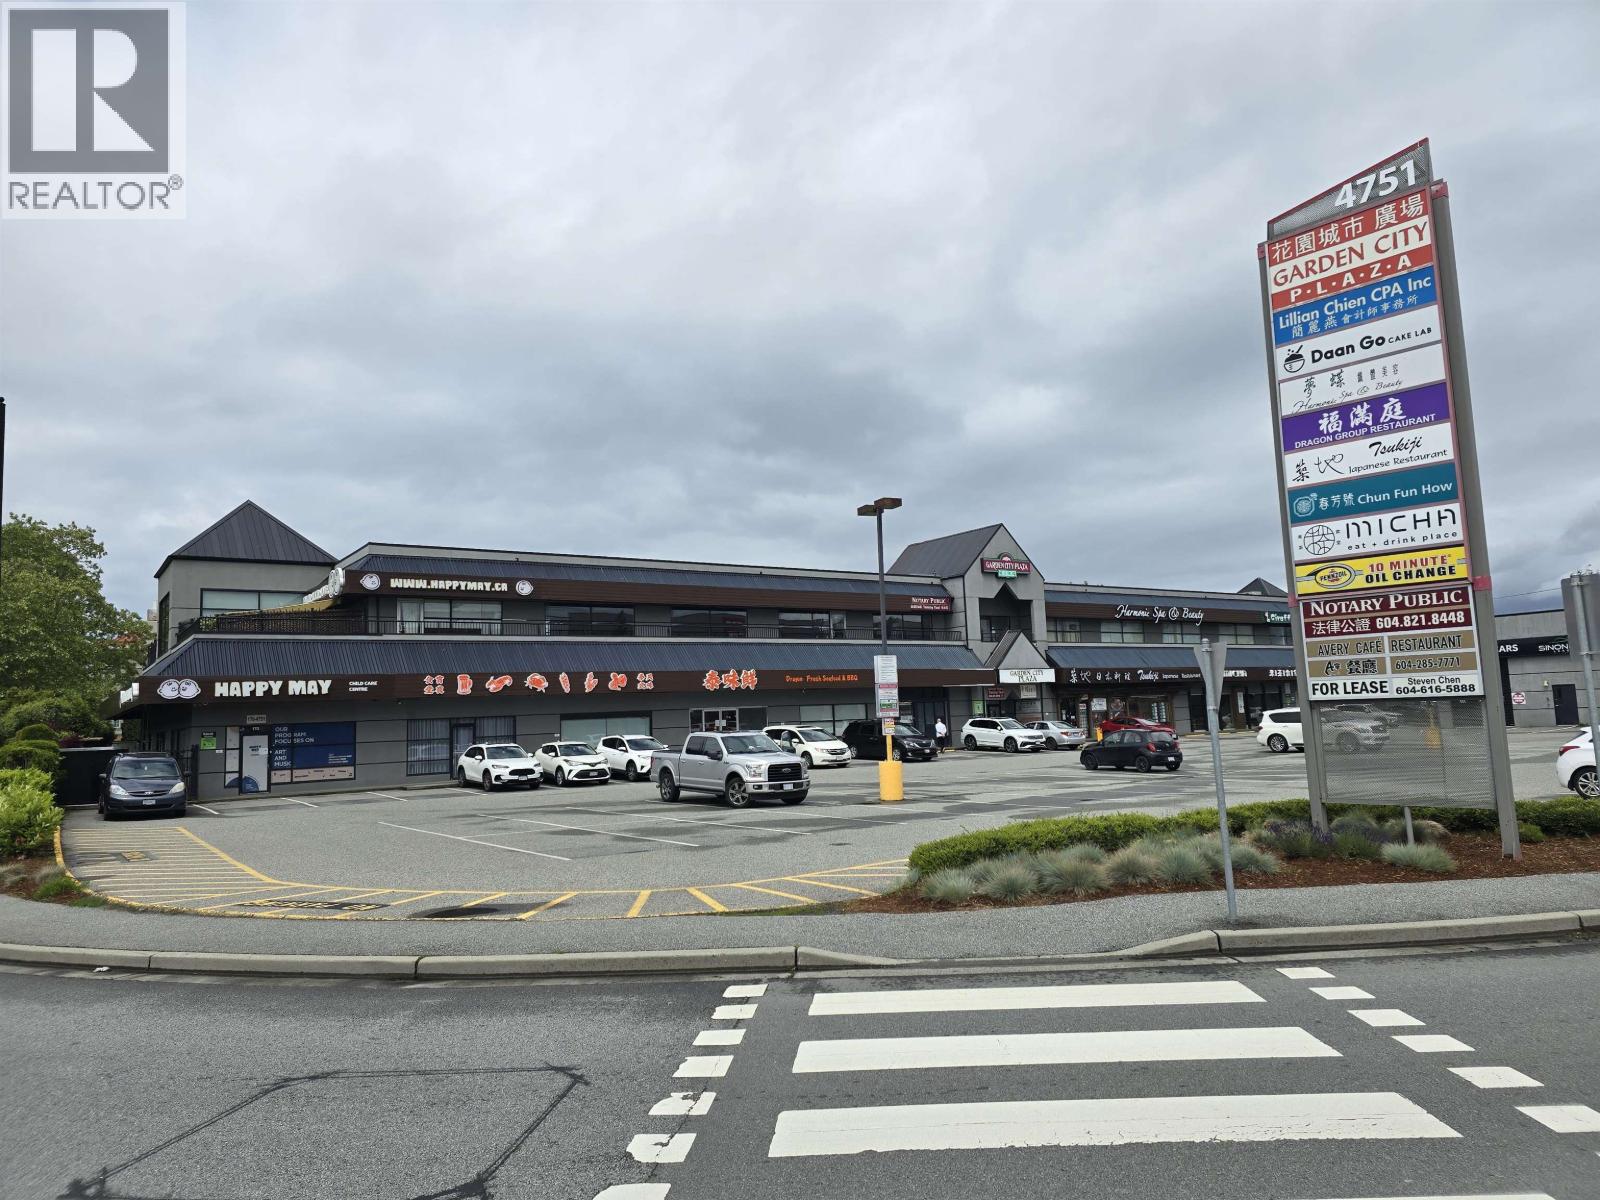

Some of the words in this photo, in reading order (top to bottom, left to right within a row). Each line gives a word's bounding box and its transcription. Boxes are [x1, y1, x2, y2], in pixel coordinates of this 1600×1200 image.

[1335, 159, 1416, 209] 4751
[1272, 215, 1364, 263] 花園城市
[1375, 194, 1424, 229] 廣場
[1273, 242, 1365, 286] GARDEN
[1374, 221, 1427, 254] CITY
[1279, 309, 1319, 329] Lillian
[1324, 296, 1367, 314] Chien
[1371, 282, 1403, 302] CPA
[1408, 277, 1431, 291] Inc
[1311, 343, 1355, 364] Daan
[1359, 335, 1386, 351] Go
[1388, 333, 1412, 344] CAKE
[1415, 327, 1432, 337] LAB
[1339, 390, 1353, 403] Spa
[1376, 379, 1403, 390] Beauty
[1319, 397, 1407, 435] 福滿庭
[1294, 434, 1333, 449] DRAGON
[1335, 427, 1367, 441] GROUP
[1370, 413, 1436, 433] RESTAURANT
[1369, 436, 1422, 457] Tsukiji
[1348, 459, 1390, 474] Japanese
[1393, 449, 1448, 465] Restaurant
[1318, 492, 1355, 511] 春芳號
[1358, 490, 1390, 504] Chun
[1394, 488, 1418, 499] Fun
[1422, 482, 1453, 495] How
[1348, 542, 1366, 551] eat
[1383, 536, 1416, 546] drink
[1422, 531, 1458, 543] place
[985, 561, 1004, 570] GARDEN
[1365, 572, 1388, 584] OIL
[1393, 565, 1456, 581] CHANGE
[1369, 562, 1385, 574] 10
[1390, 555, 1448, 571] MINUTE
[1320, 571, 1347, 582] PENNZOIL
[1311, 598, 1384, 616] NOTARY
[1388, 590, 1463, 609] PUBLIC
[1115, 604, 1150, 619] Harmonic
[1152, 606, 1167, 624] Spa
[1182, 607, 1205, 626] Beauty
[1312, 619, 1371, 635] 法律公證
[1376, 611, 1465, 629] 604.821.8448
[1318, 643, 1350, 657] AVERY
[1356, 639, 1382, 654] CAFÉ
[1391, 635, 1462, 648] RESTAURANT
[1395, 656, 1460, 670] 604-285-7771
[214, 680, 283, 697] HAPPY
[288, 679, 332, 696] MAY
[1312, 682, 1339, 696] FOR
[1343, 681, 1388, 695] LEASE
[1395, 684, 1475, 695] 604-616-5888
[1407, 677, 1436, 686] Steven
[1438, 676, 1461, 684] Chen
